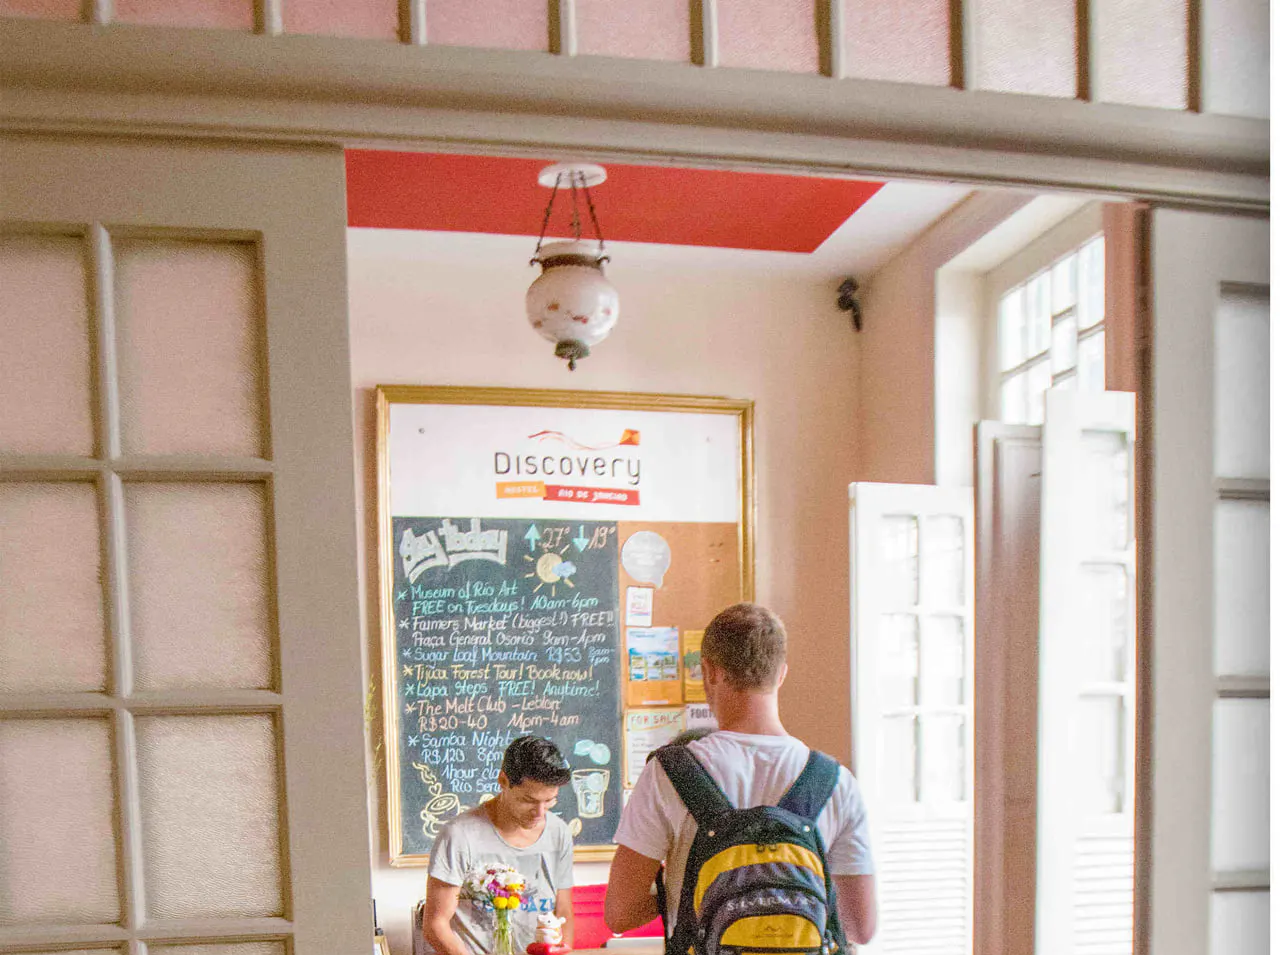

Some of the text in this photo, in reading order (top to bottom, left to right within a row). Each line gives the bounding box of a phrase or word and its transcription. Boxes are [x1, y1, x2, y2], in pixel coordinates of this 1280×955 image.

[494, 452, 640, 485] Discovery
[410, 584, 455, 600] Museum
[473, 580, 494, 597] Rio
[498, 579, 518, 596] Art
[413, 600, 446, 616] FREE
[448, 604, 464, 613] on
[464, 613, 508, 631] Market
[449, 630, 492, 650] General
[414, 648, 450, 669] Sugar
[452, 645, 478, 668] Loaf
[482, 646, 538, 662] Mountain
[414, 663, 448, 687] Tijuca
[451, 663, 491, 680] Forest
[526, 664, 561, 680] Book
[416, 681, 448, 700] Lapa
[454, 680, 488, 701] Steps
[417, 700, 442, 716] The
[446, 696, 474, 714] Melt
[478, 695, 506, 713] Club
[422, 731, 466, 748] Samba
[482, 762, 502, 780] cla
[450, 778, 473, 792] Rio
